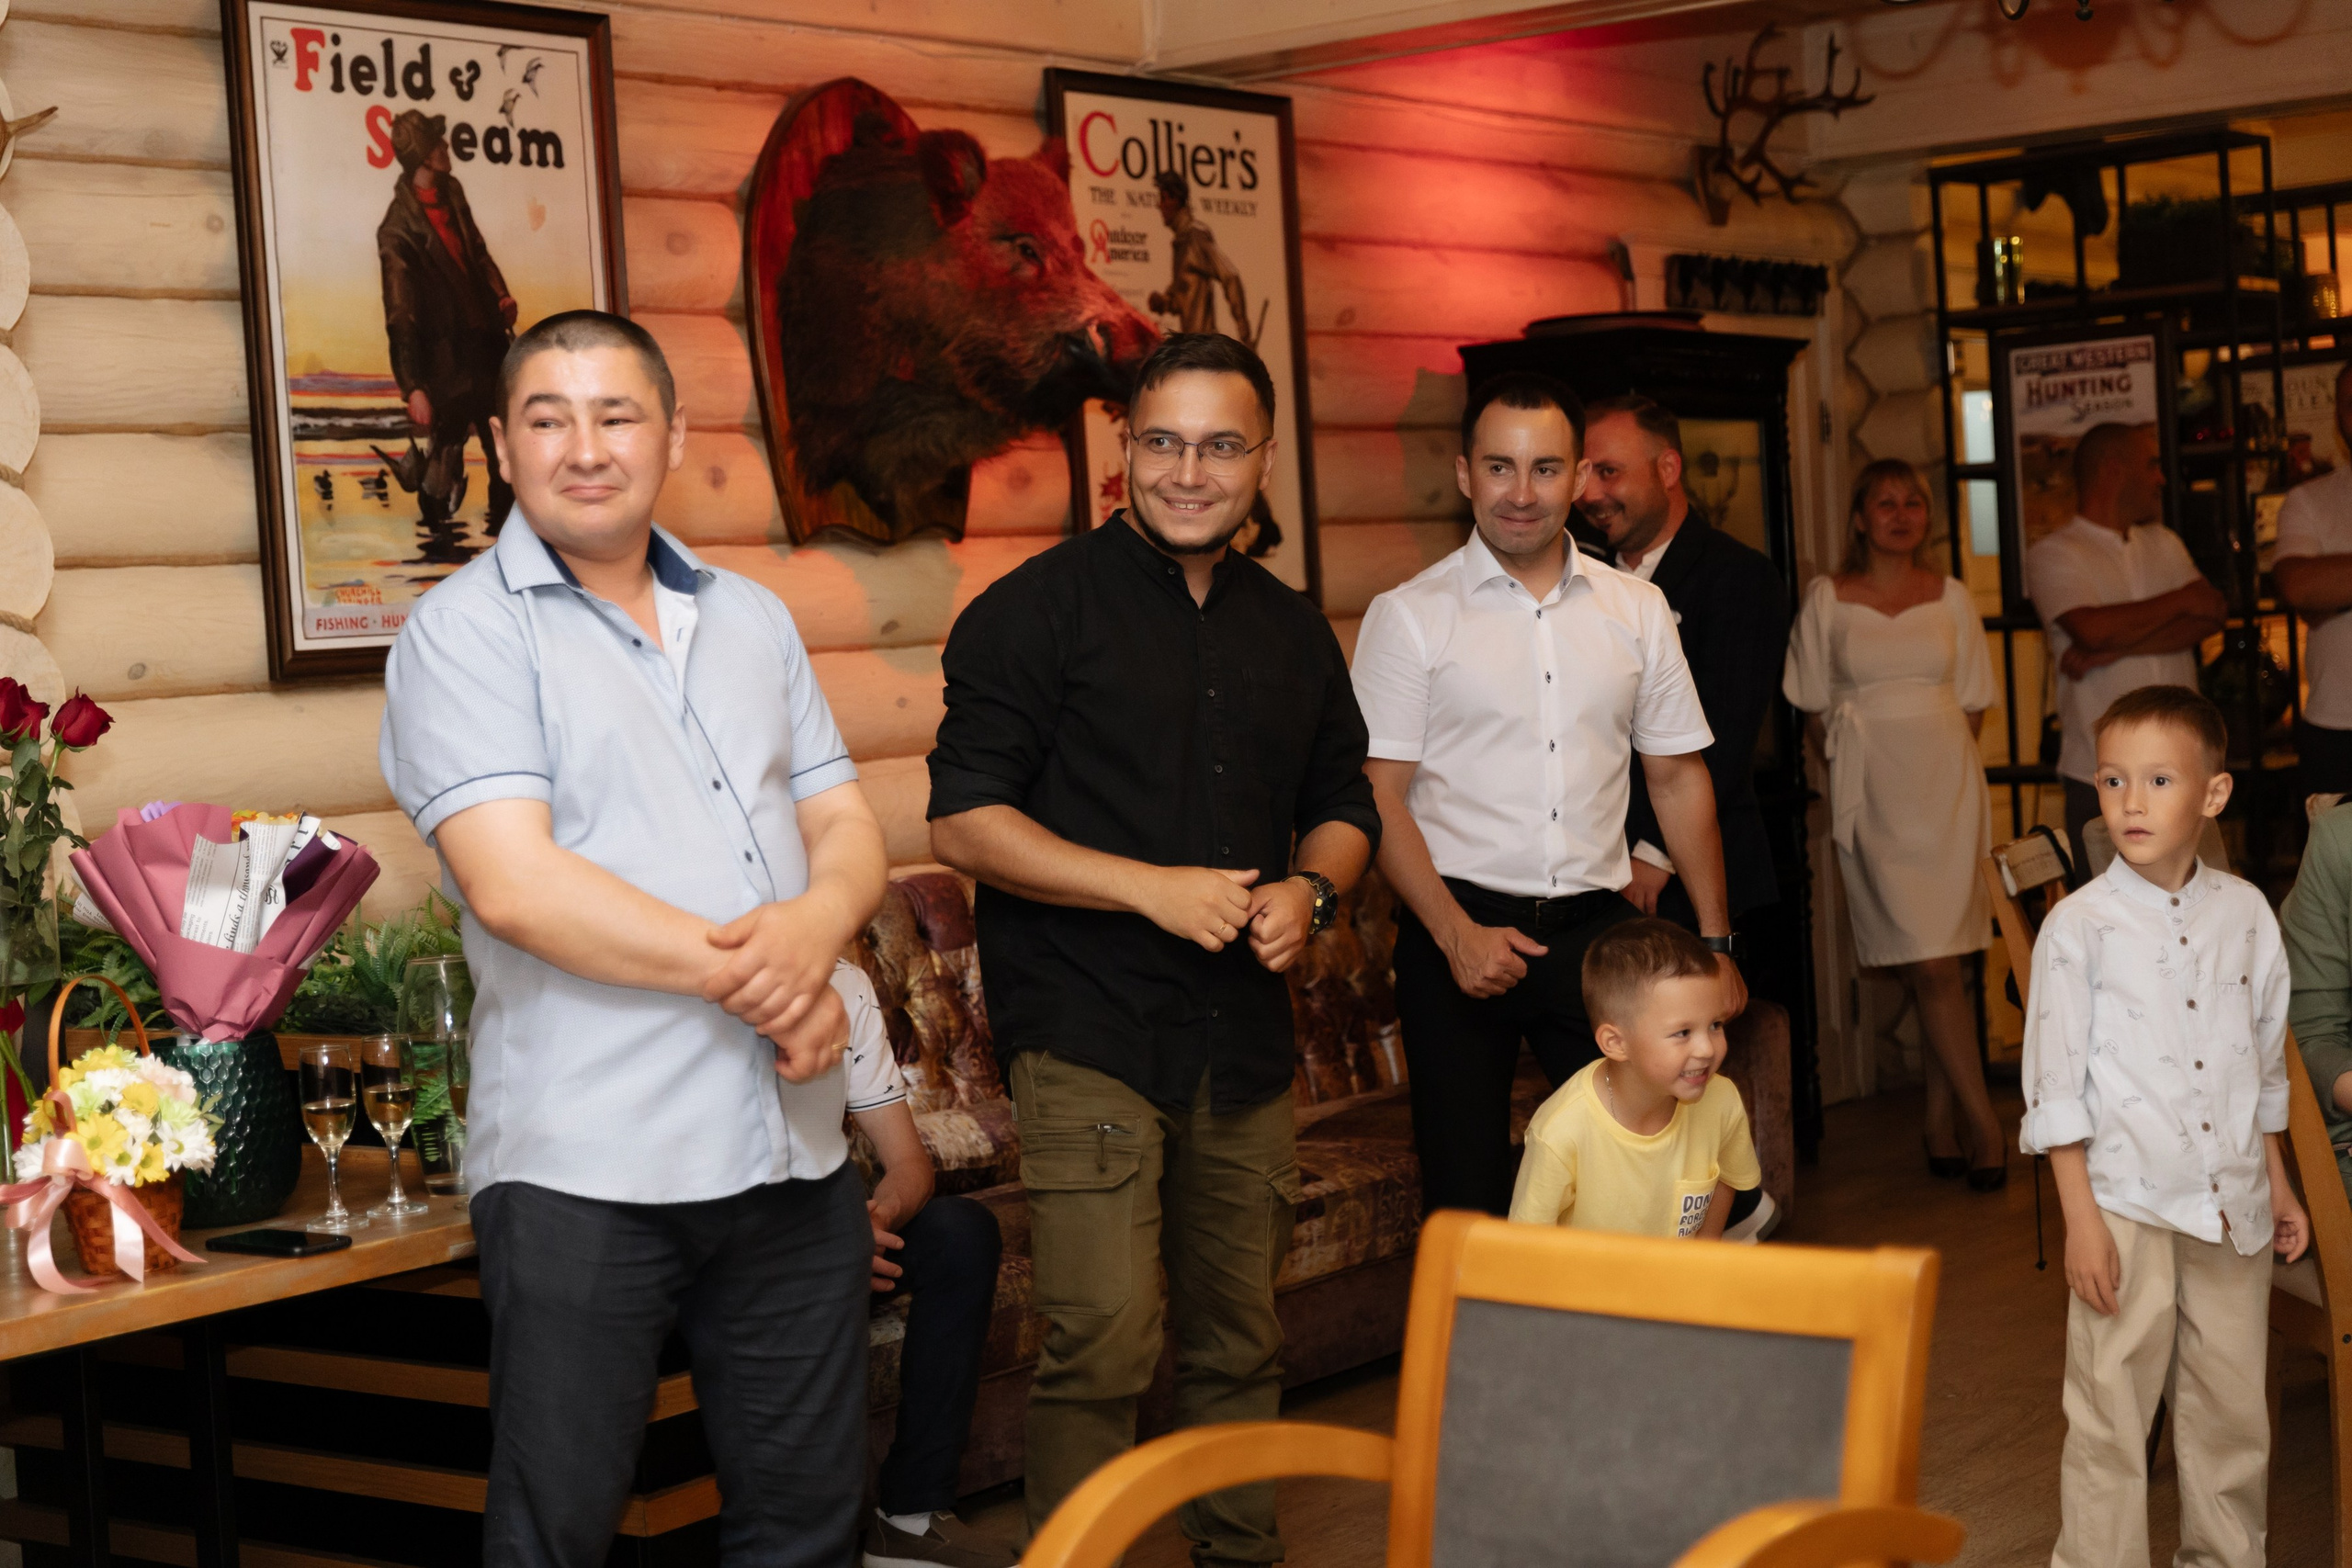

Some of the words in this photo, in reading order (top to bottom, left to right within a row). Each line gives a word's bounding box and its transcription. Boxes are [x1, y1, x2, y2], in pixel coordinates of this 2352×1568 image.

[290, 28, 435, 101] Field
[448, 60, 481, 101] &
[365, 105, 565, 169] Seam
[1079, 110, 1259, 190] Collier's
[1090, 186, 1115, 206] THE
[1199, 197, 1258, 217] WEEKLY
[2026, 373, 2132, 406] HUNTING
[315, 615, 368, 631] FISHING
